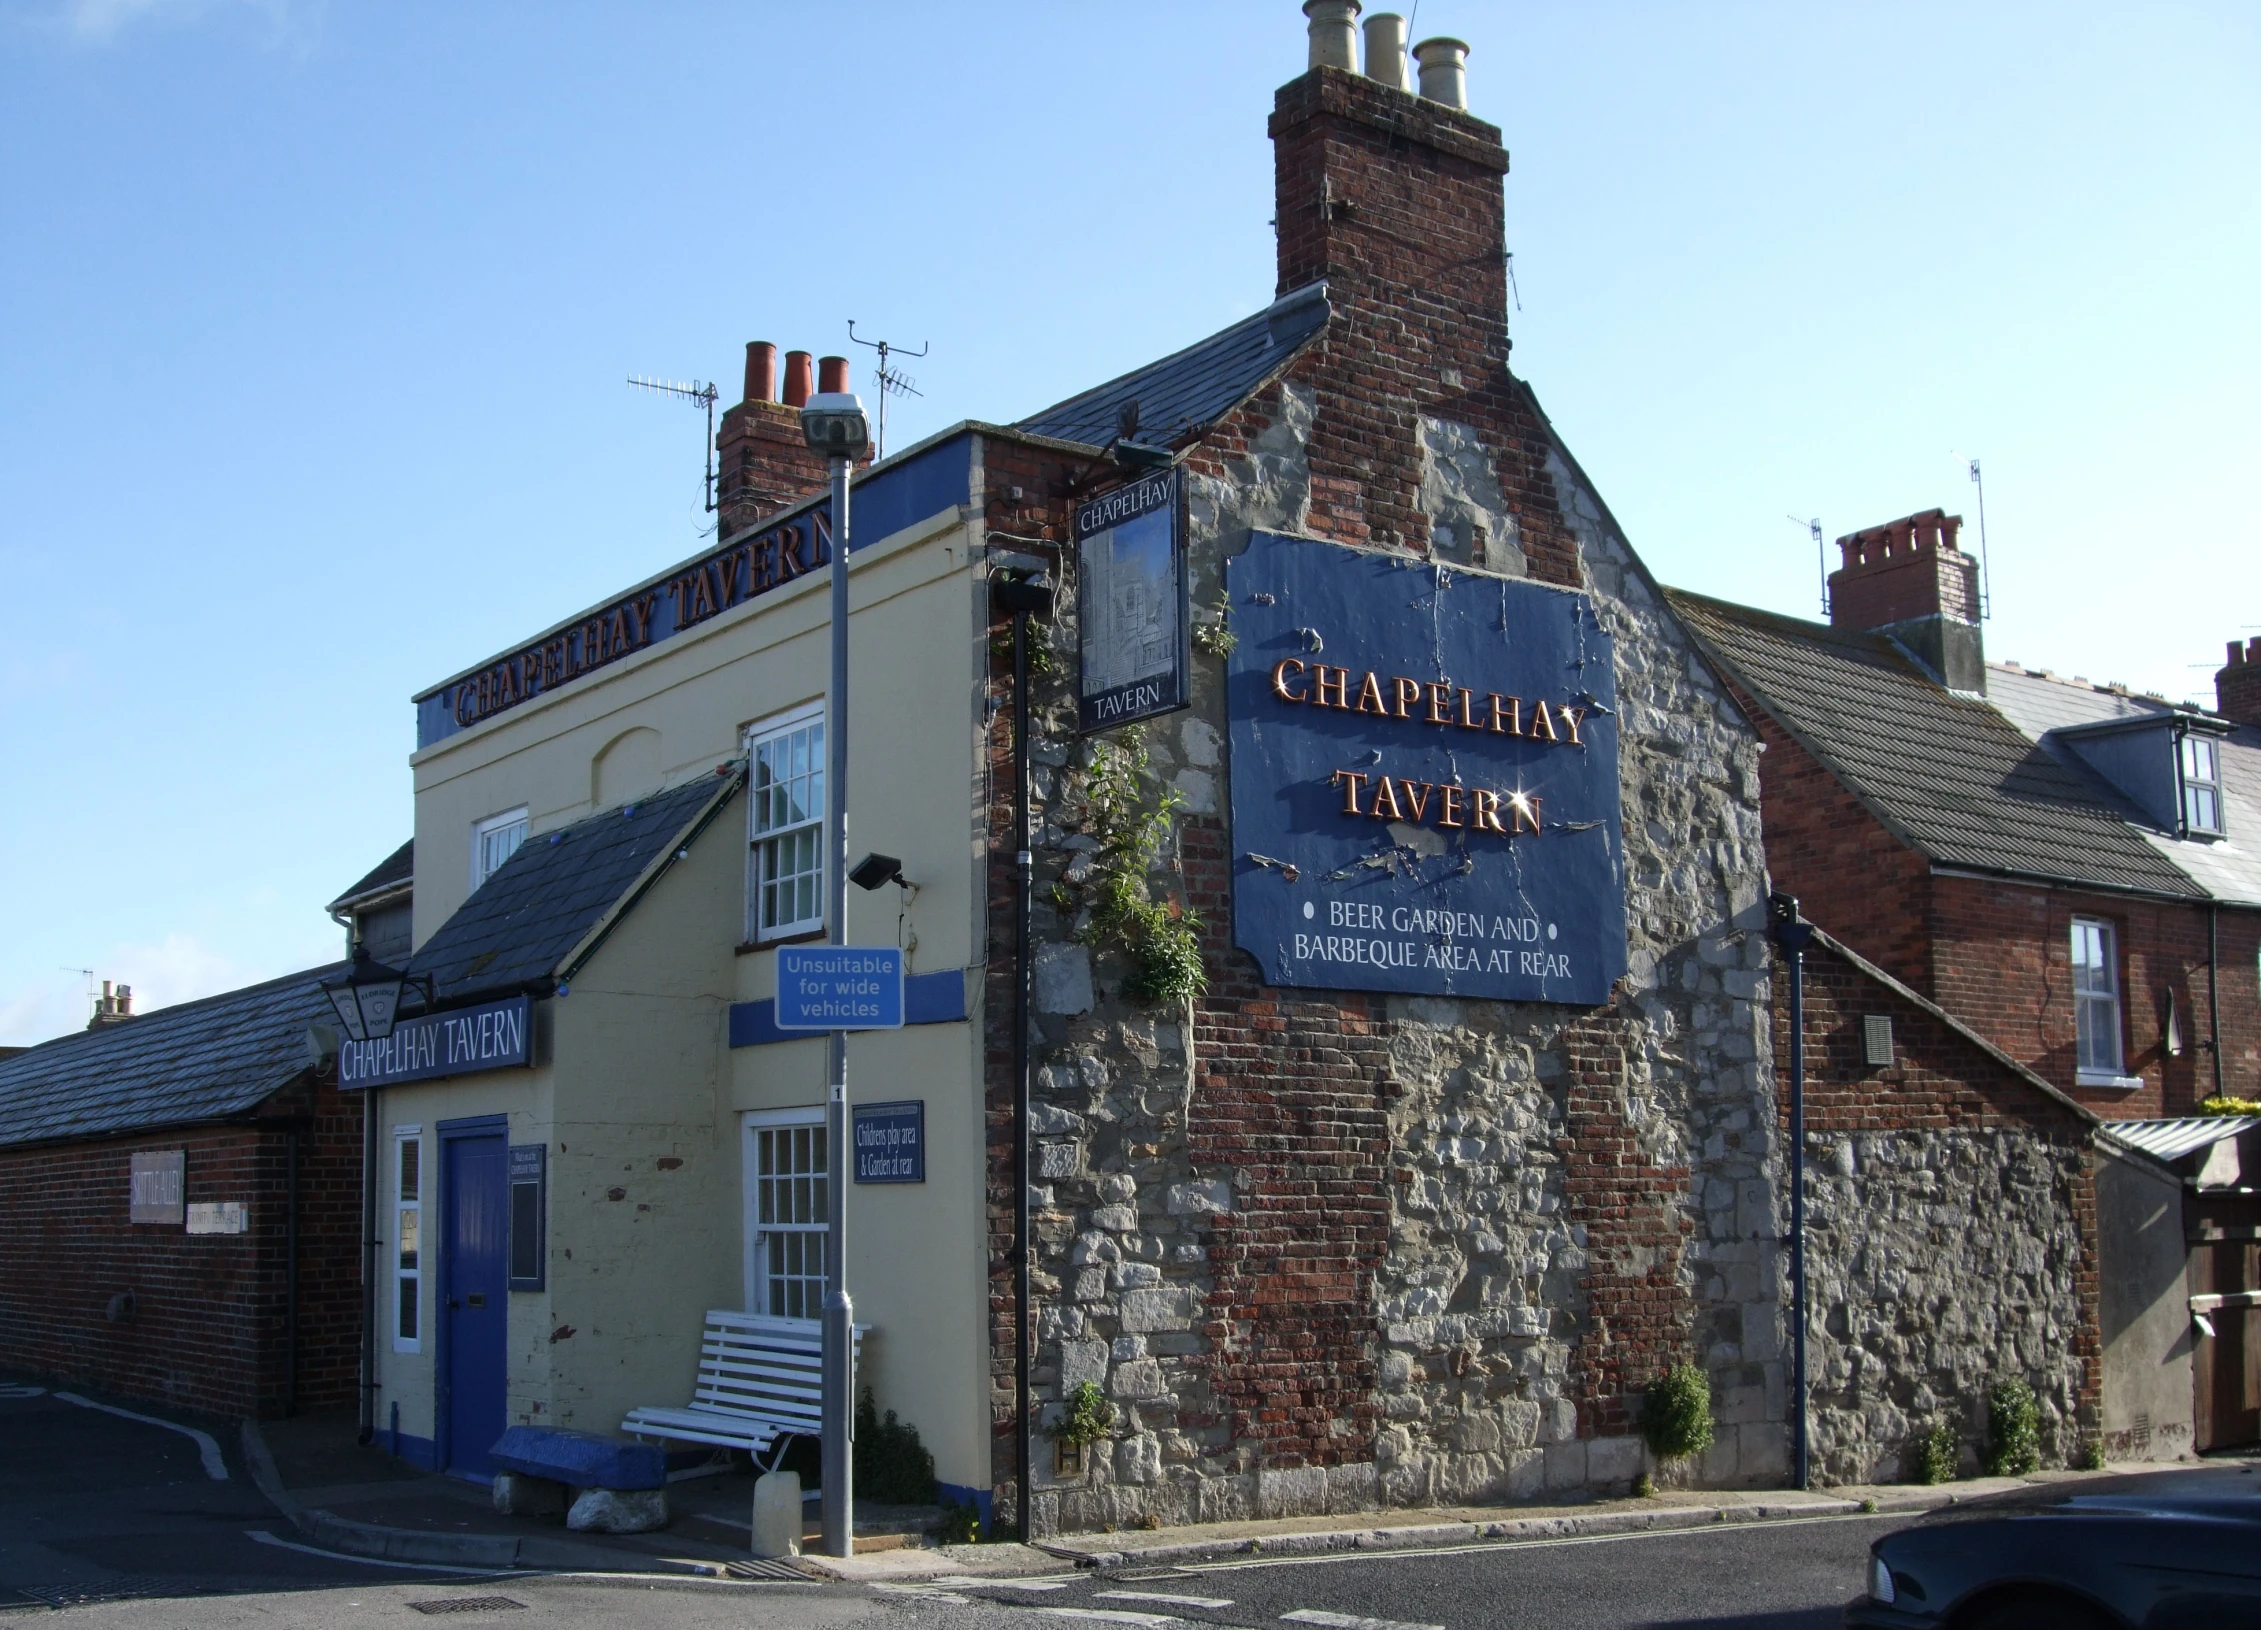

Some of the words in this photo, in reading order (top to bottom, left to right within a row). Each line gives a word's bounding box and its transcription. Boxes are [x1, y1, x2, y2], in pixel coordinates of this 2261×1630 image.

[1081, 477, 1171, 532] CHAPELHAY
[454, 592, 655, 728] CHAPELHAY
[1094, 682, 1160, 719] TAVERN
[1271, 658, 1587, 745] CHAPELHAY
[1333, 769, 1543, 836] TAVERN
[1330, 901, 1386, 930] BEER
[1392, 907, 1484, 938] GARDEN
[1491, 916, 1539, 942] AND
[787, 957, 892, 973] Unsuitable
[1295, 934, 1417, 969] BARBEQUE
[1423, 944, 1482, 972] AREA
[1487, 949, 1513, 973] AT
[1521, 951, 1572, 978] REAR
[800, 978, 828, 995] for
[835, 978, 880, 995] wide
[800, 1000, 879, 1016] vehicles
[342, 1022, 439, 1081] CHAPELHAY
[444, 1008, 523, 1065] TAVERN
[835, 1088, 840, 1099] 1
[856, 1122, 886, 1147] Childrens
[887, 1121, 901, 1154] play
[902, 1127, 916, 1145] area
[861, 1154, 867, 1176] &
[868, 1152, 891, 1176] Garden
[892, 1154, 898, 1175] at
[900, 1158, 913, 1175] rear
